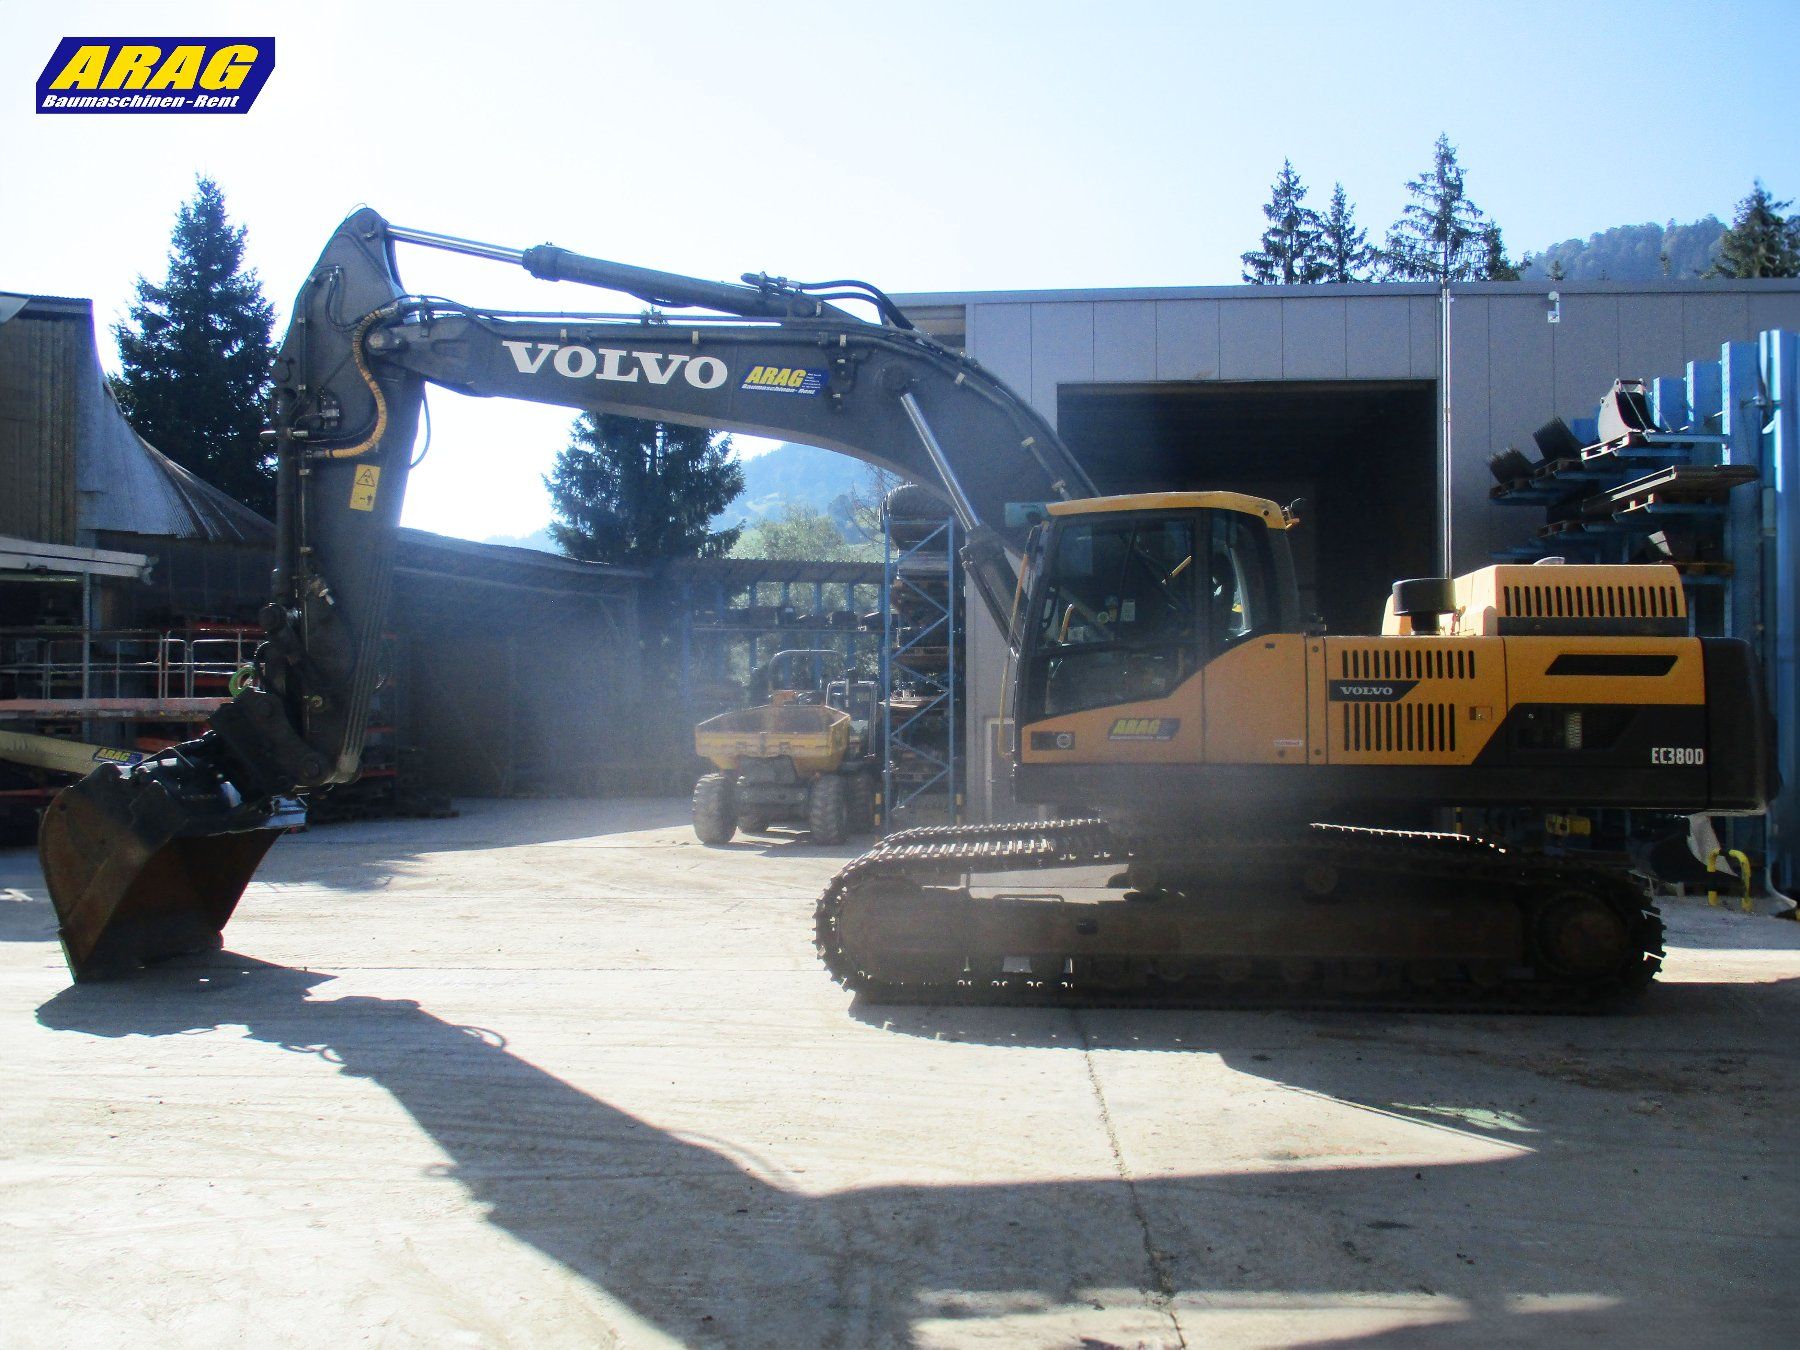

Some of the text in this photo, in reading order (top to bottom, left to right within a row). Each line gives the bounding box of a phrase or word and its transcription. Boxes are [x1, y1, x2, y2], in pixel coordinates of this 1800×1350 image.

[502, 340, 728, 389] VOLVO
[745, 366, 807, 387] ARAG
[1340, 686, 1393, 695] VOLVO
[1651, 747, 1704, 765] EC380D
